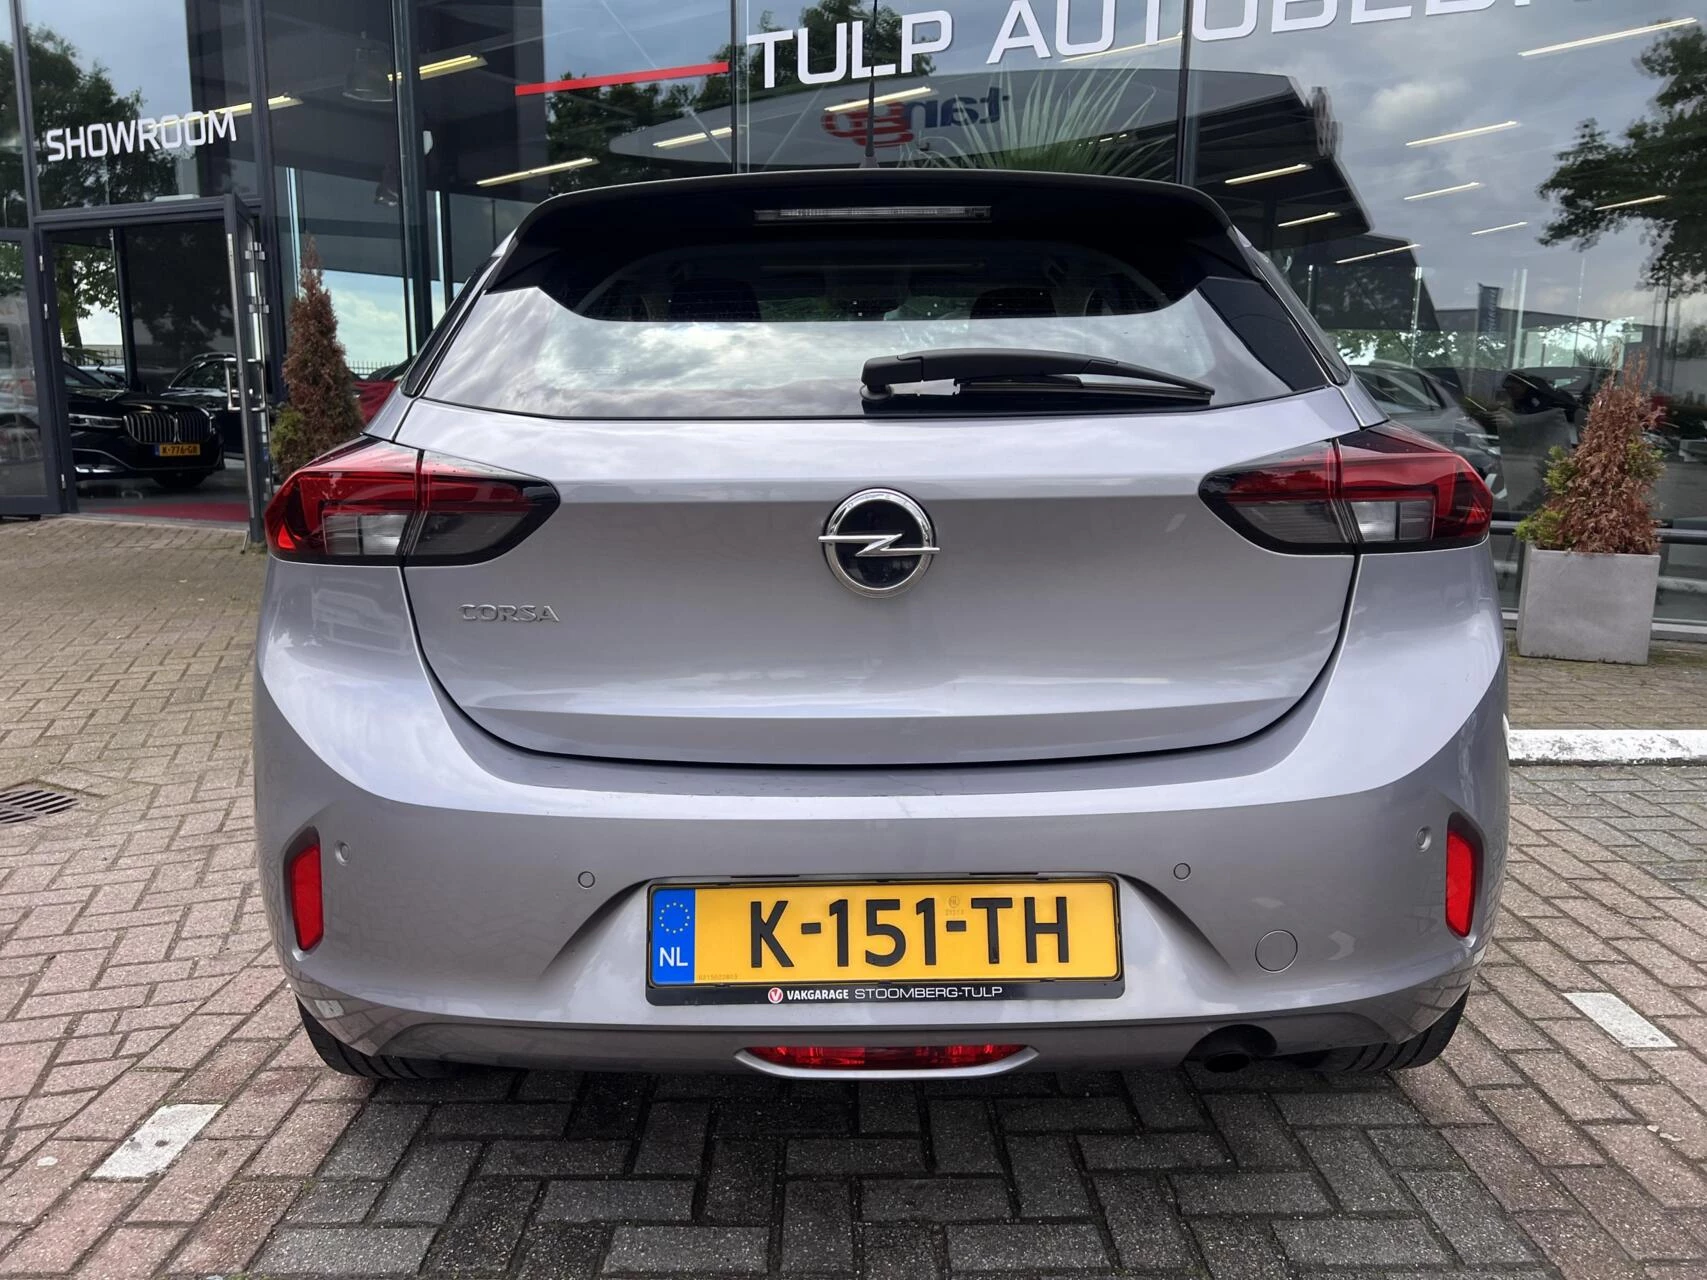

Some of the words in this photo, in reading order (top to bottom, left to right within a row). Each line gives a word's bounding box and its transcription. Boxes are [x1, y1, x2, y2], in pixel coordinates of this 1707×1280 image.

[746, 10, 954, 89] TULP
[46, 109, 237, 162] SHOWROOM
[460, 603, 560, 622] CORSA
[750, 896, 1070, 969] K-151-TH
[659, 946, 689, 968] NL
[786, 989, 849, 1000] VAKGARAGE
[854, 986, 1003, 999] STOOMBERG-TULP
